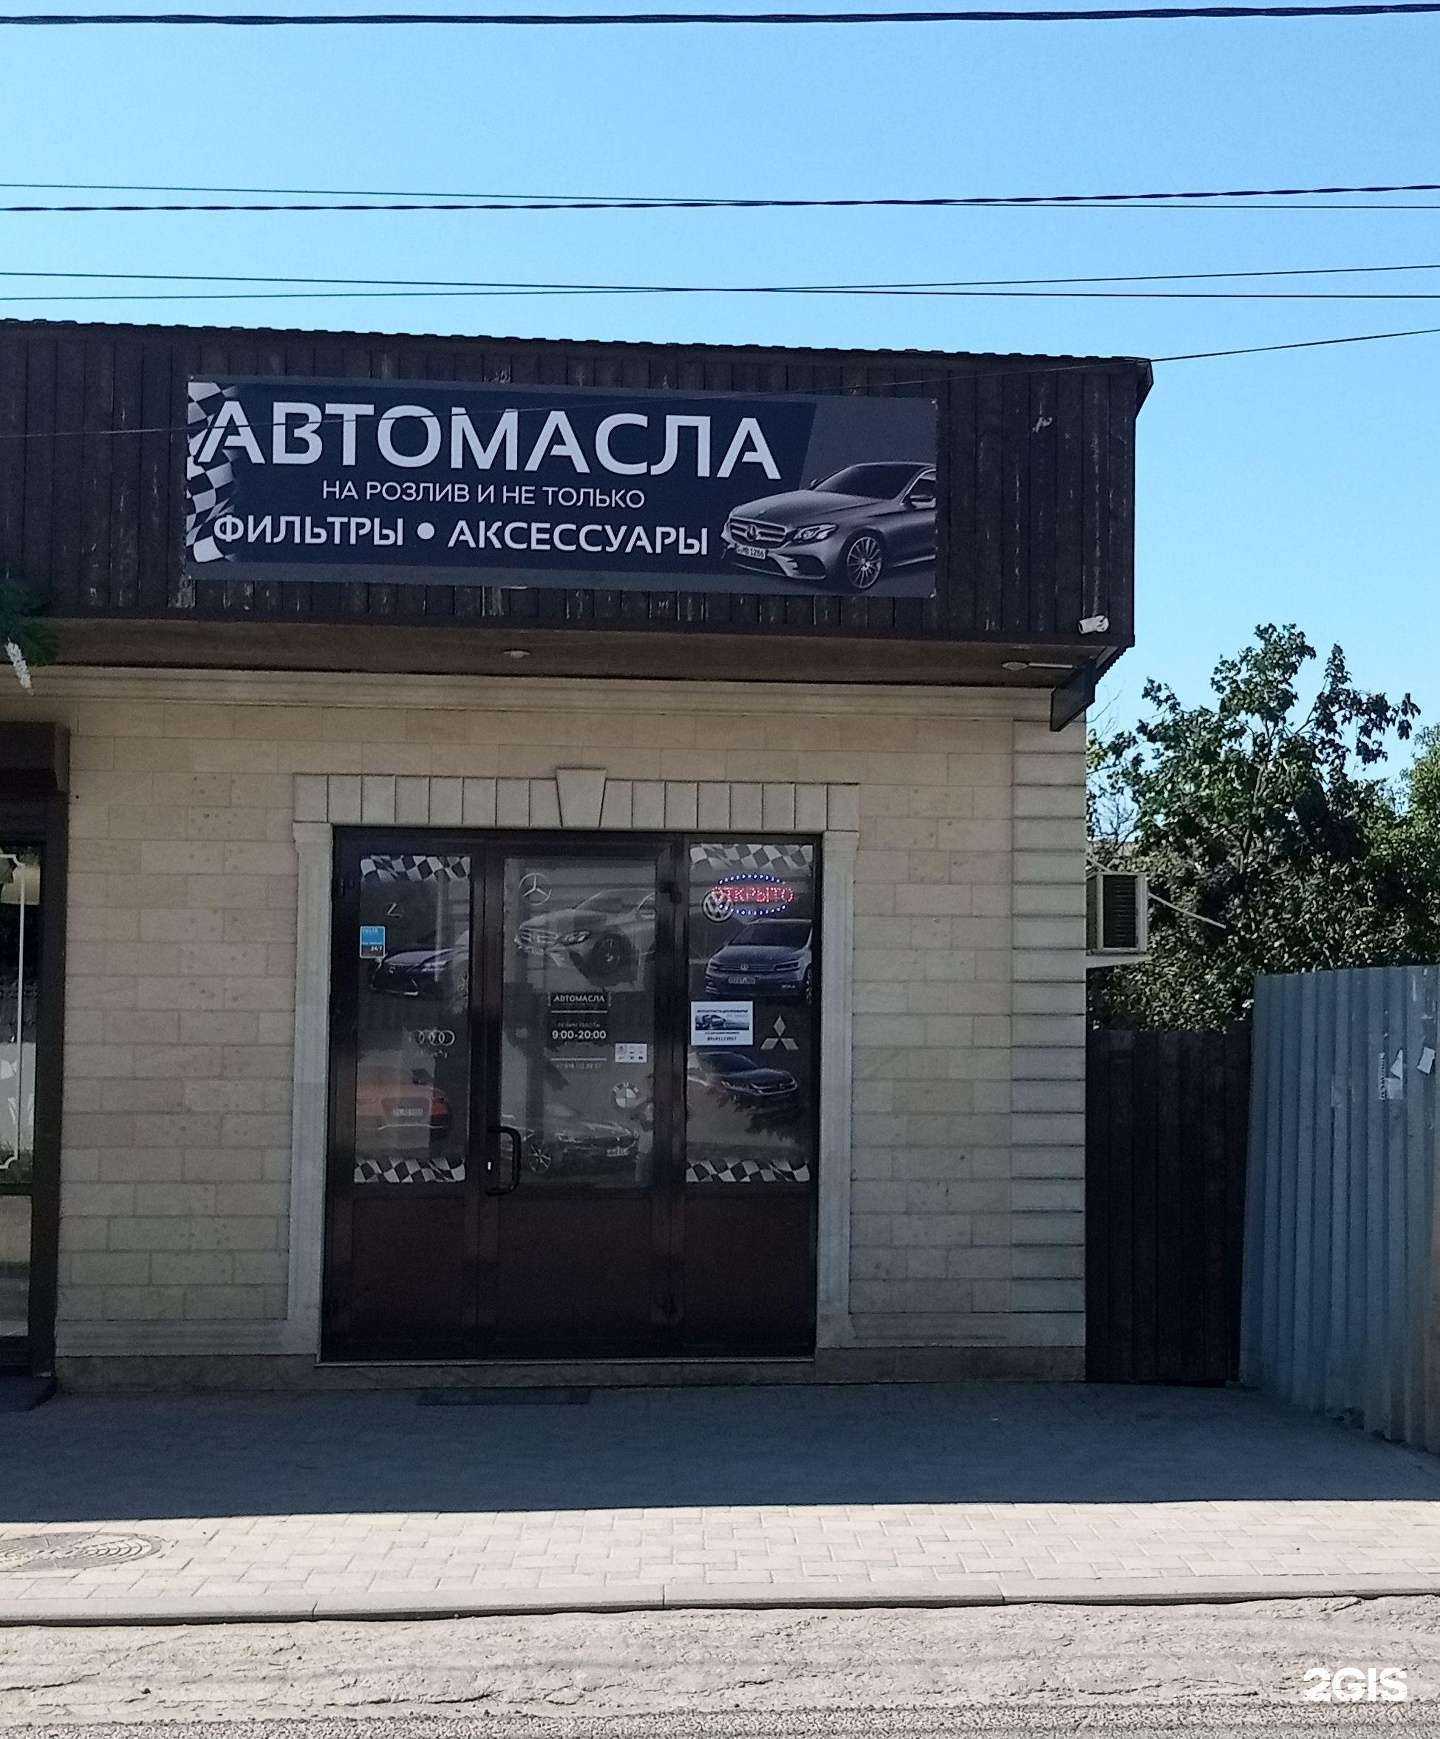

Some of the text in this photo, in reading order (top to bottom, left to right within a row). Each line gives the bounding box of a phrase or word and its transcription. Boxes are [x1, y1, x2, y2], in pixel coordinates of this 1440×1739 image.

[198, 401, 781, 479] АВТОМАСЛА
[322, 480, 645, 508] НА РОЗЛИВ И НЕ ТОЛЬКО
[214, 514, 708, 556] ФИЛЬТРЫ АКСЕССУАРЫ
[553, 994, 606, 1003] АВТОМАСЛА
